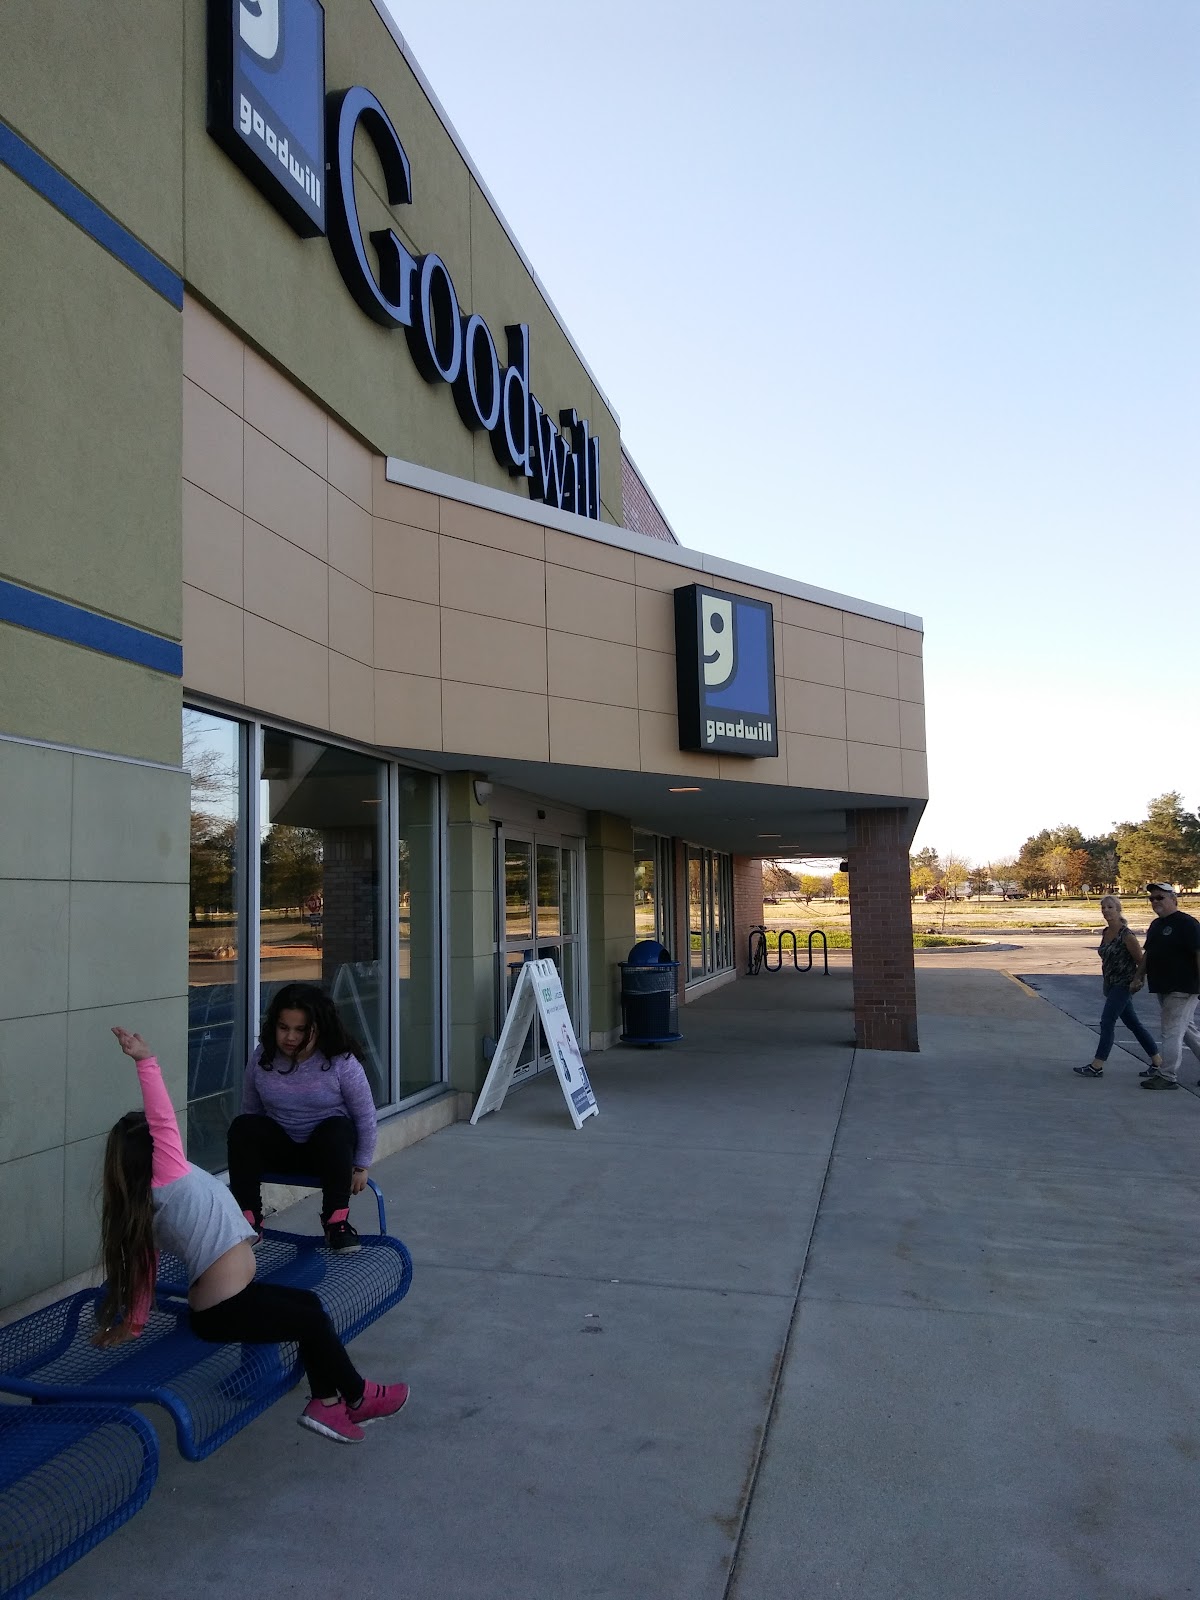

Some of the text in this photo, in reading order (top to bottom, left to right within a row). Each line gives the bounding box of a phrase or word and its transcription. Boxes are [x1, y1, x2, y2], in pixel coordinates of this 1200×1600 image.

[239, 93, 321, 208] goodwill
[334, 86, 601, 521] Goodwill
[706, 719, 772, 744] goodwill
